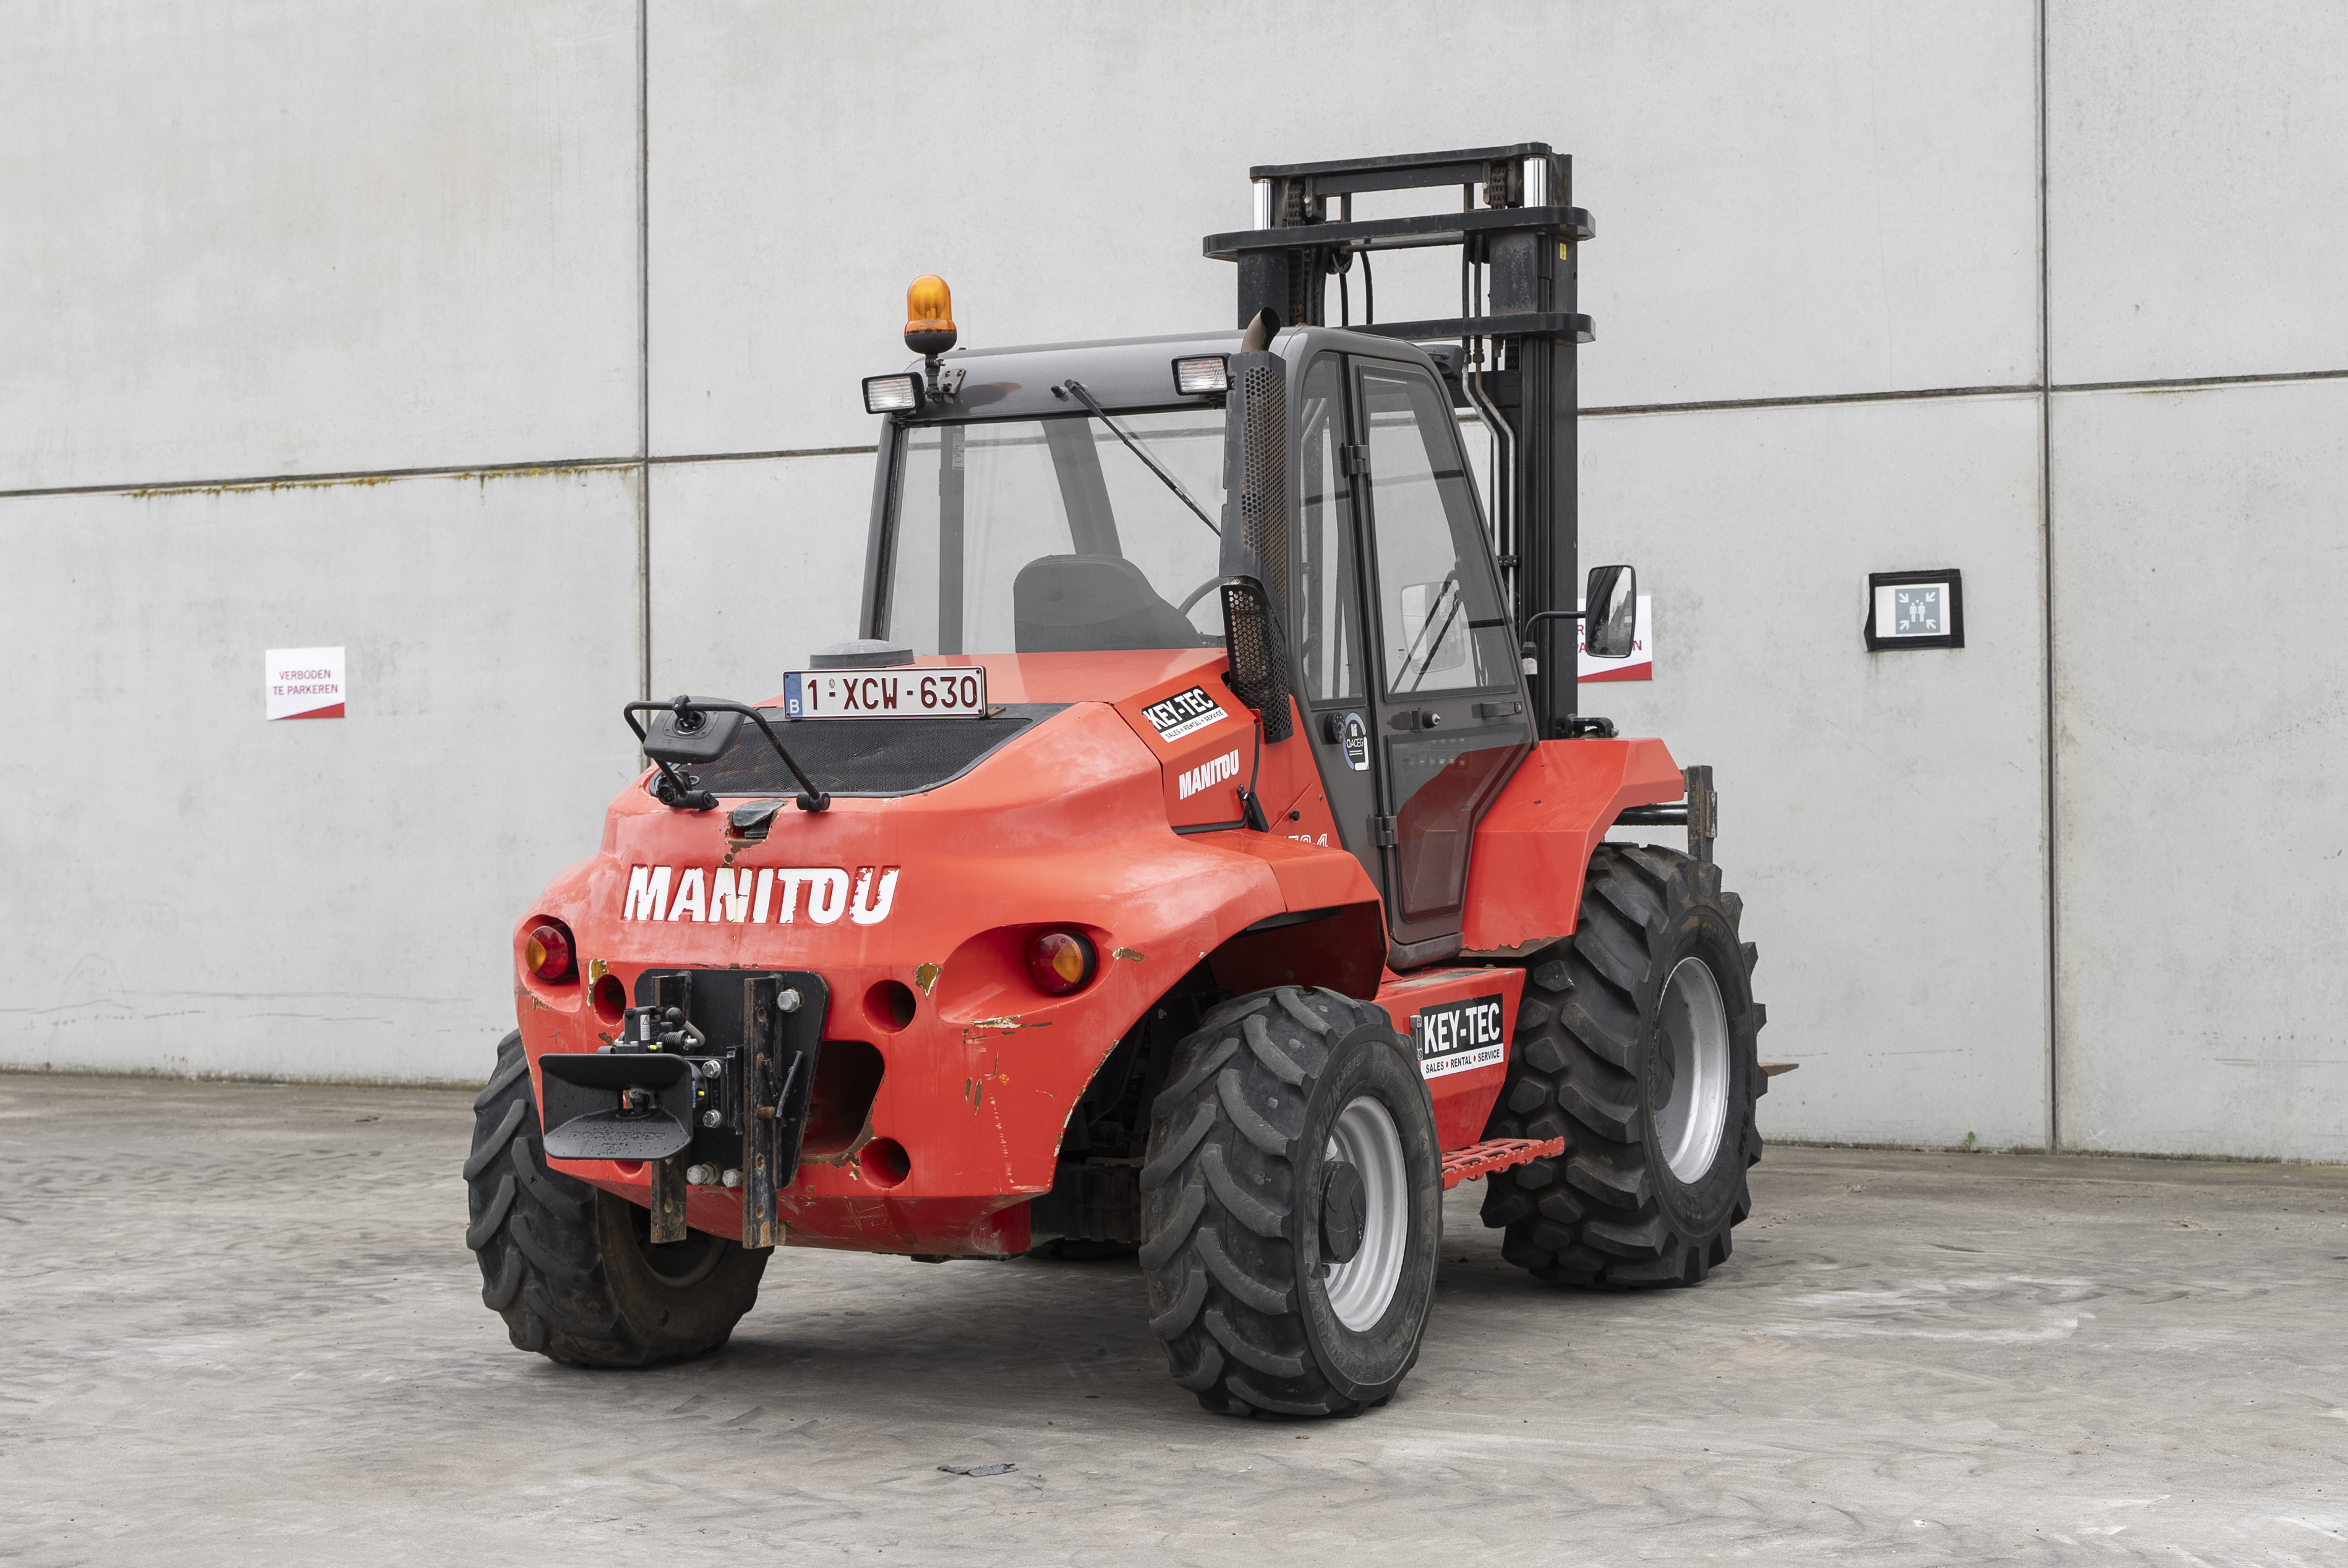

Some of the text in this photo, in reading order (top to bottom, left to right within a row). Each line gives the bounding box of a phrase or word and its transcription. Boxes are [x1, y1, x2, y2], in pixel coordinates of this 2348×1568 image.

[280, 670, 331, 680] VERBODEN
[273, 684, 338, 696] TE PARKEREN
[789, 699, 800, 714] B
[1143, 688, 1214, 730] KEY-TEC
[1165, 710, 1224, 739] SALES RENTAL SERVICE
[1179, 749, 1240, 800] MANITOU
[622, 866, 901, 925] MANITOU
[1424, 1002, 1500, 1054] KEY-TEC
[1425, 1049, 1500, 1075] SALES RENTAL SERVICE
